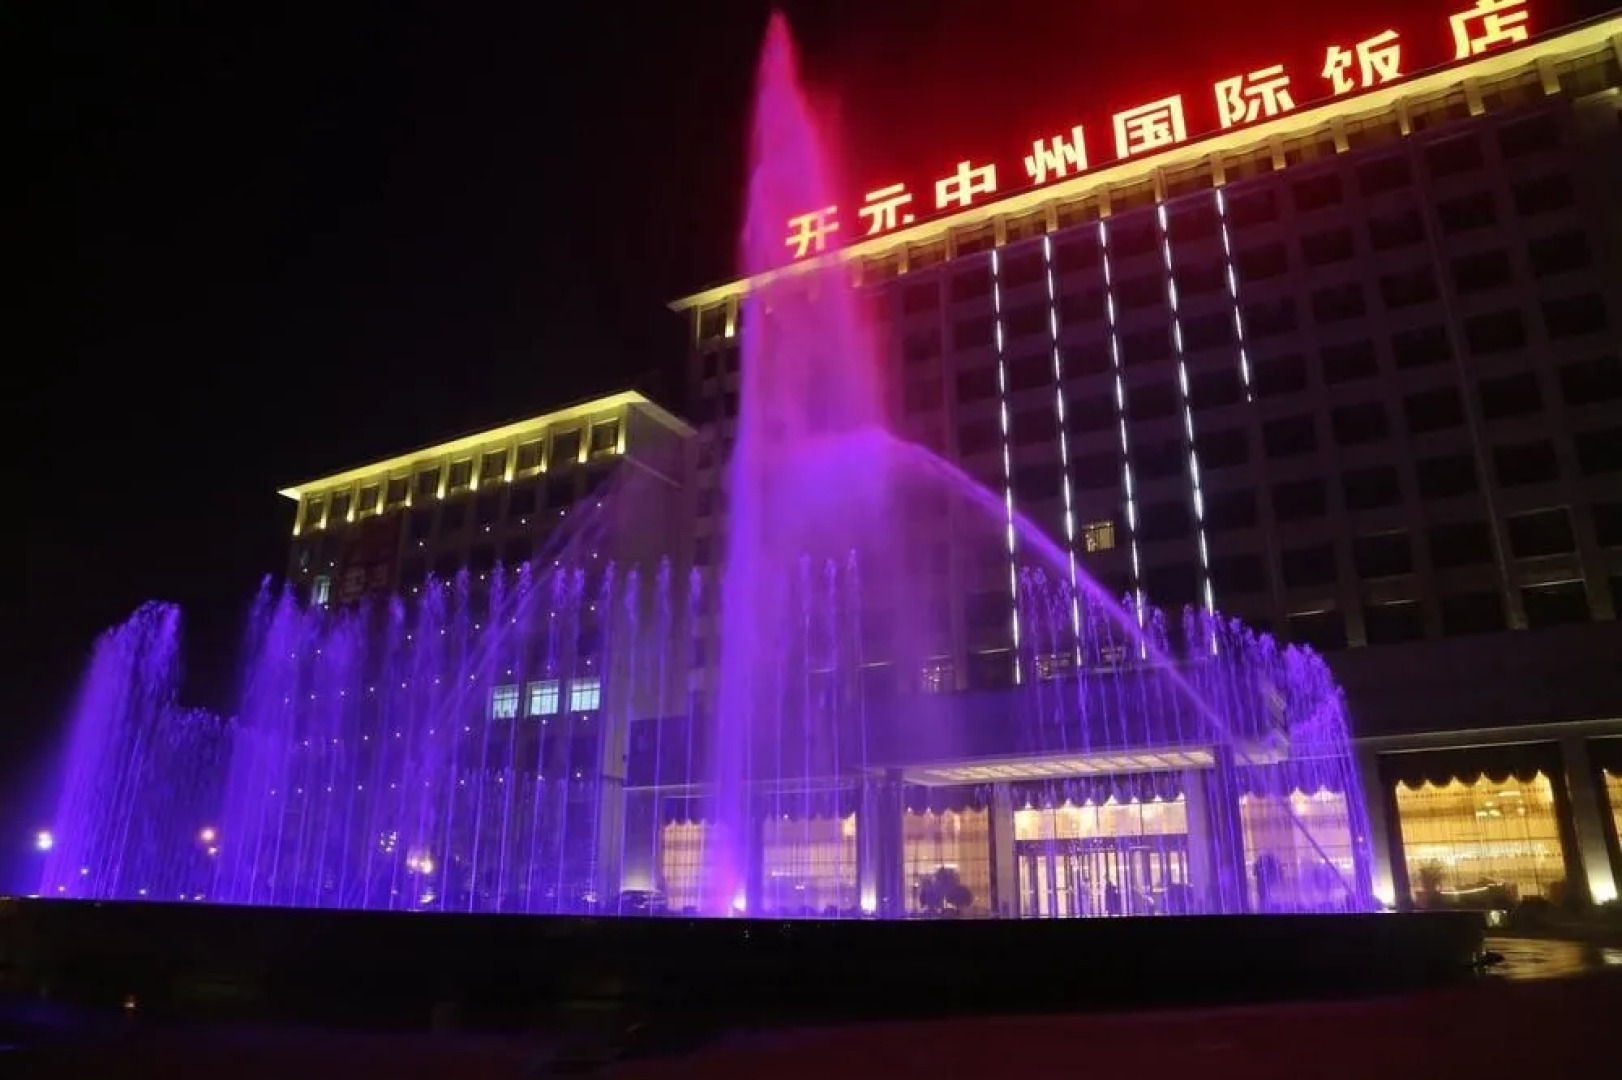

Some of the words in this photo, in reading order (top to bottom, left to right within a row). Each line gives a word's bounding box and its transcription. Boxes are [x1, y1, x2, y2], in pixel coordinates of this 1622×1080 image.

[785, 0, 1528, 258] 开元中州国际饭店
